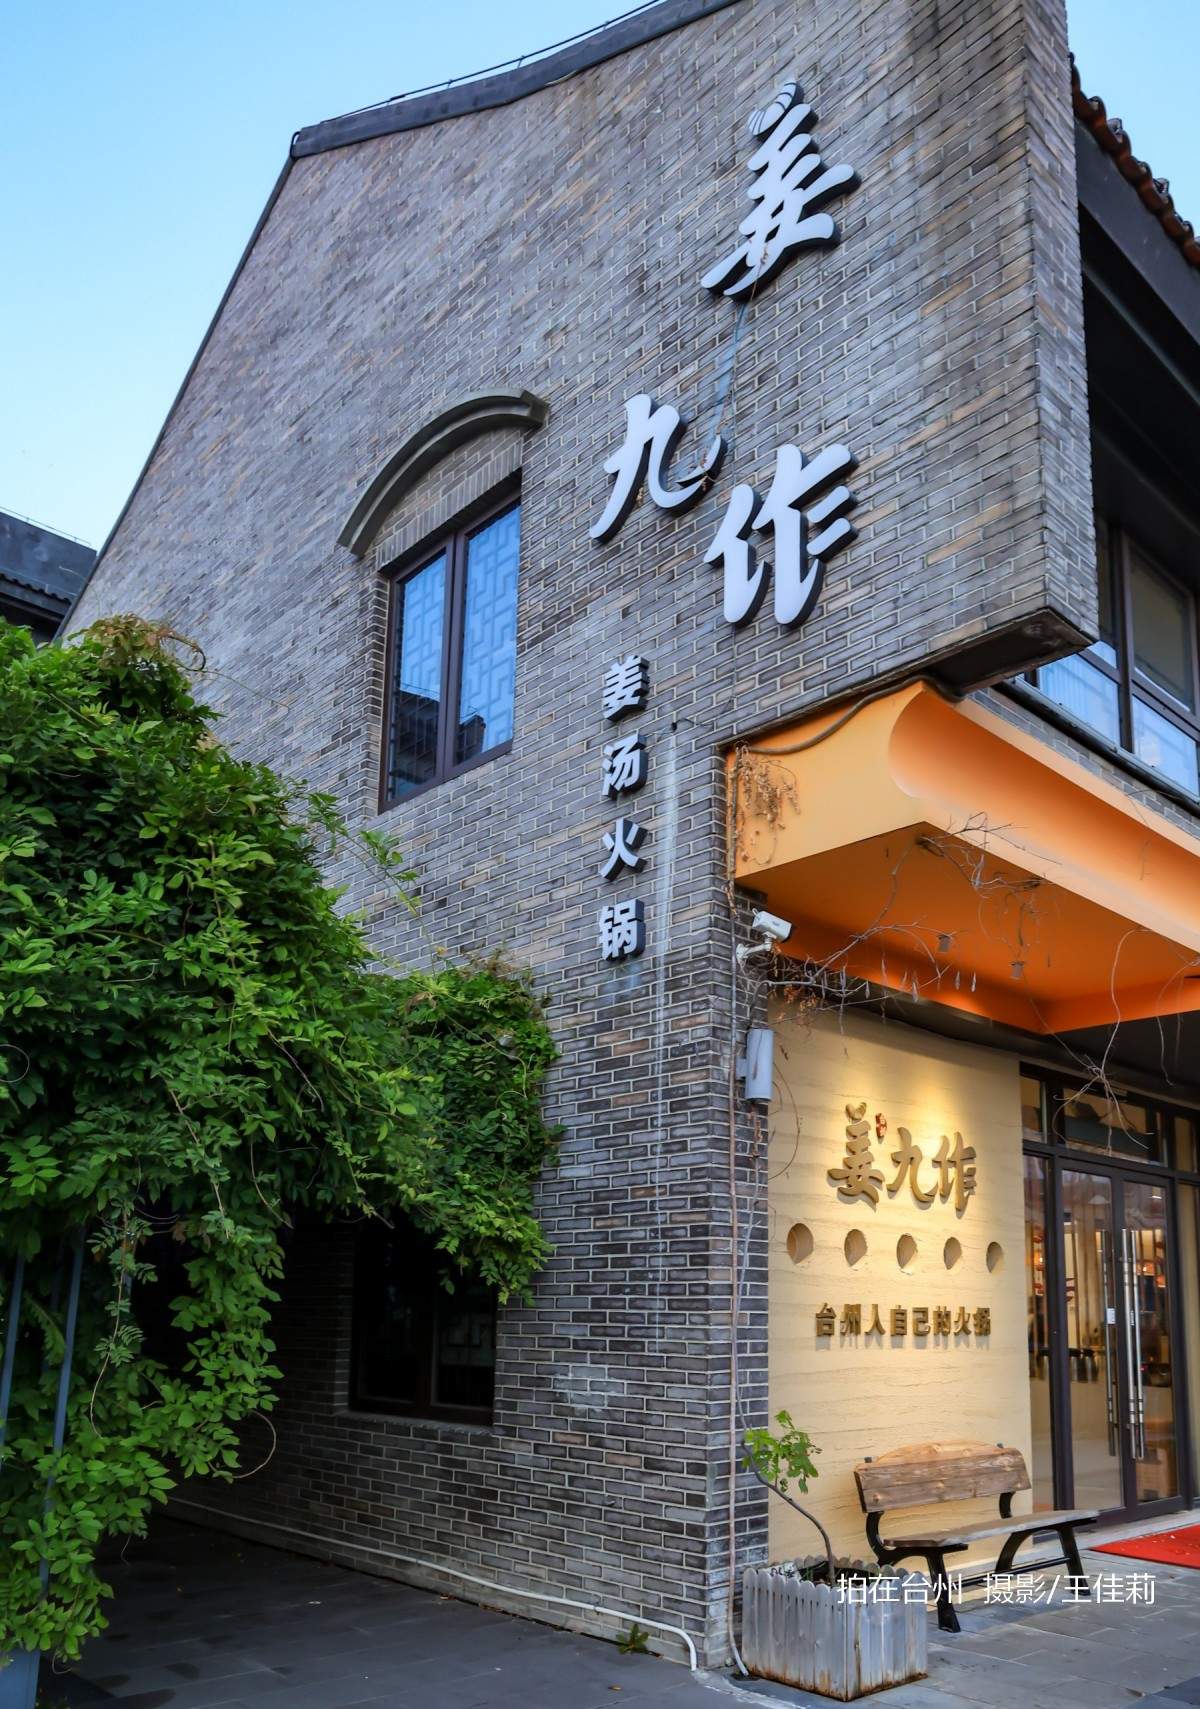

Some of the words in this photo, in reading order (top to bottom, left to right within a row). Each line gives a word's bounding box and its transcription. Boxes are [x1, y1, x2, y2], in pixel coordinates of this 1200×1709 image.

[589, 80, 860, 628] 姜九作
[600, 655, 650, 962] 姜汤火锅
[827, 1101, 977, 1213] 姜九作
[815, 1302, 992, 1338] 台州人自己的火锅
